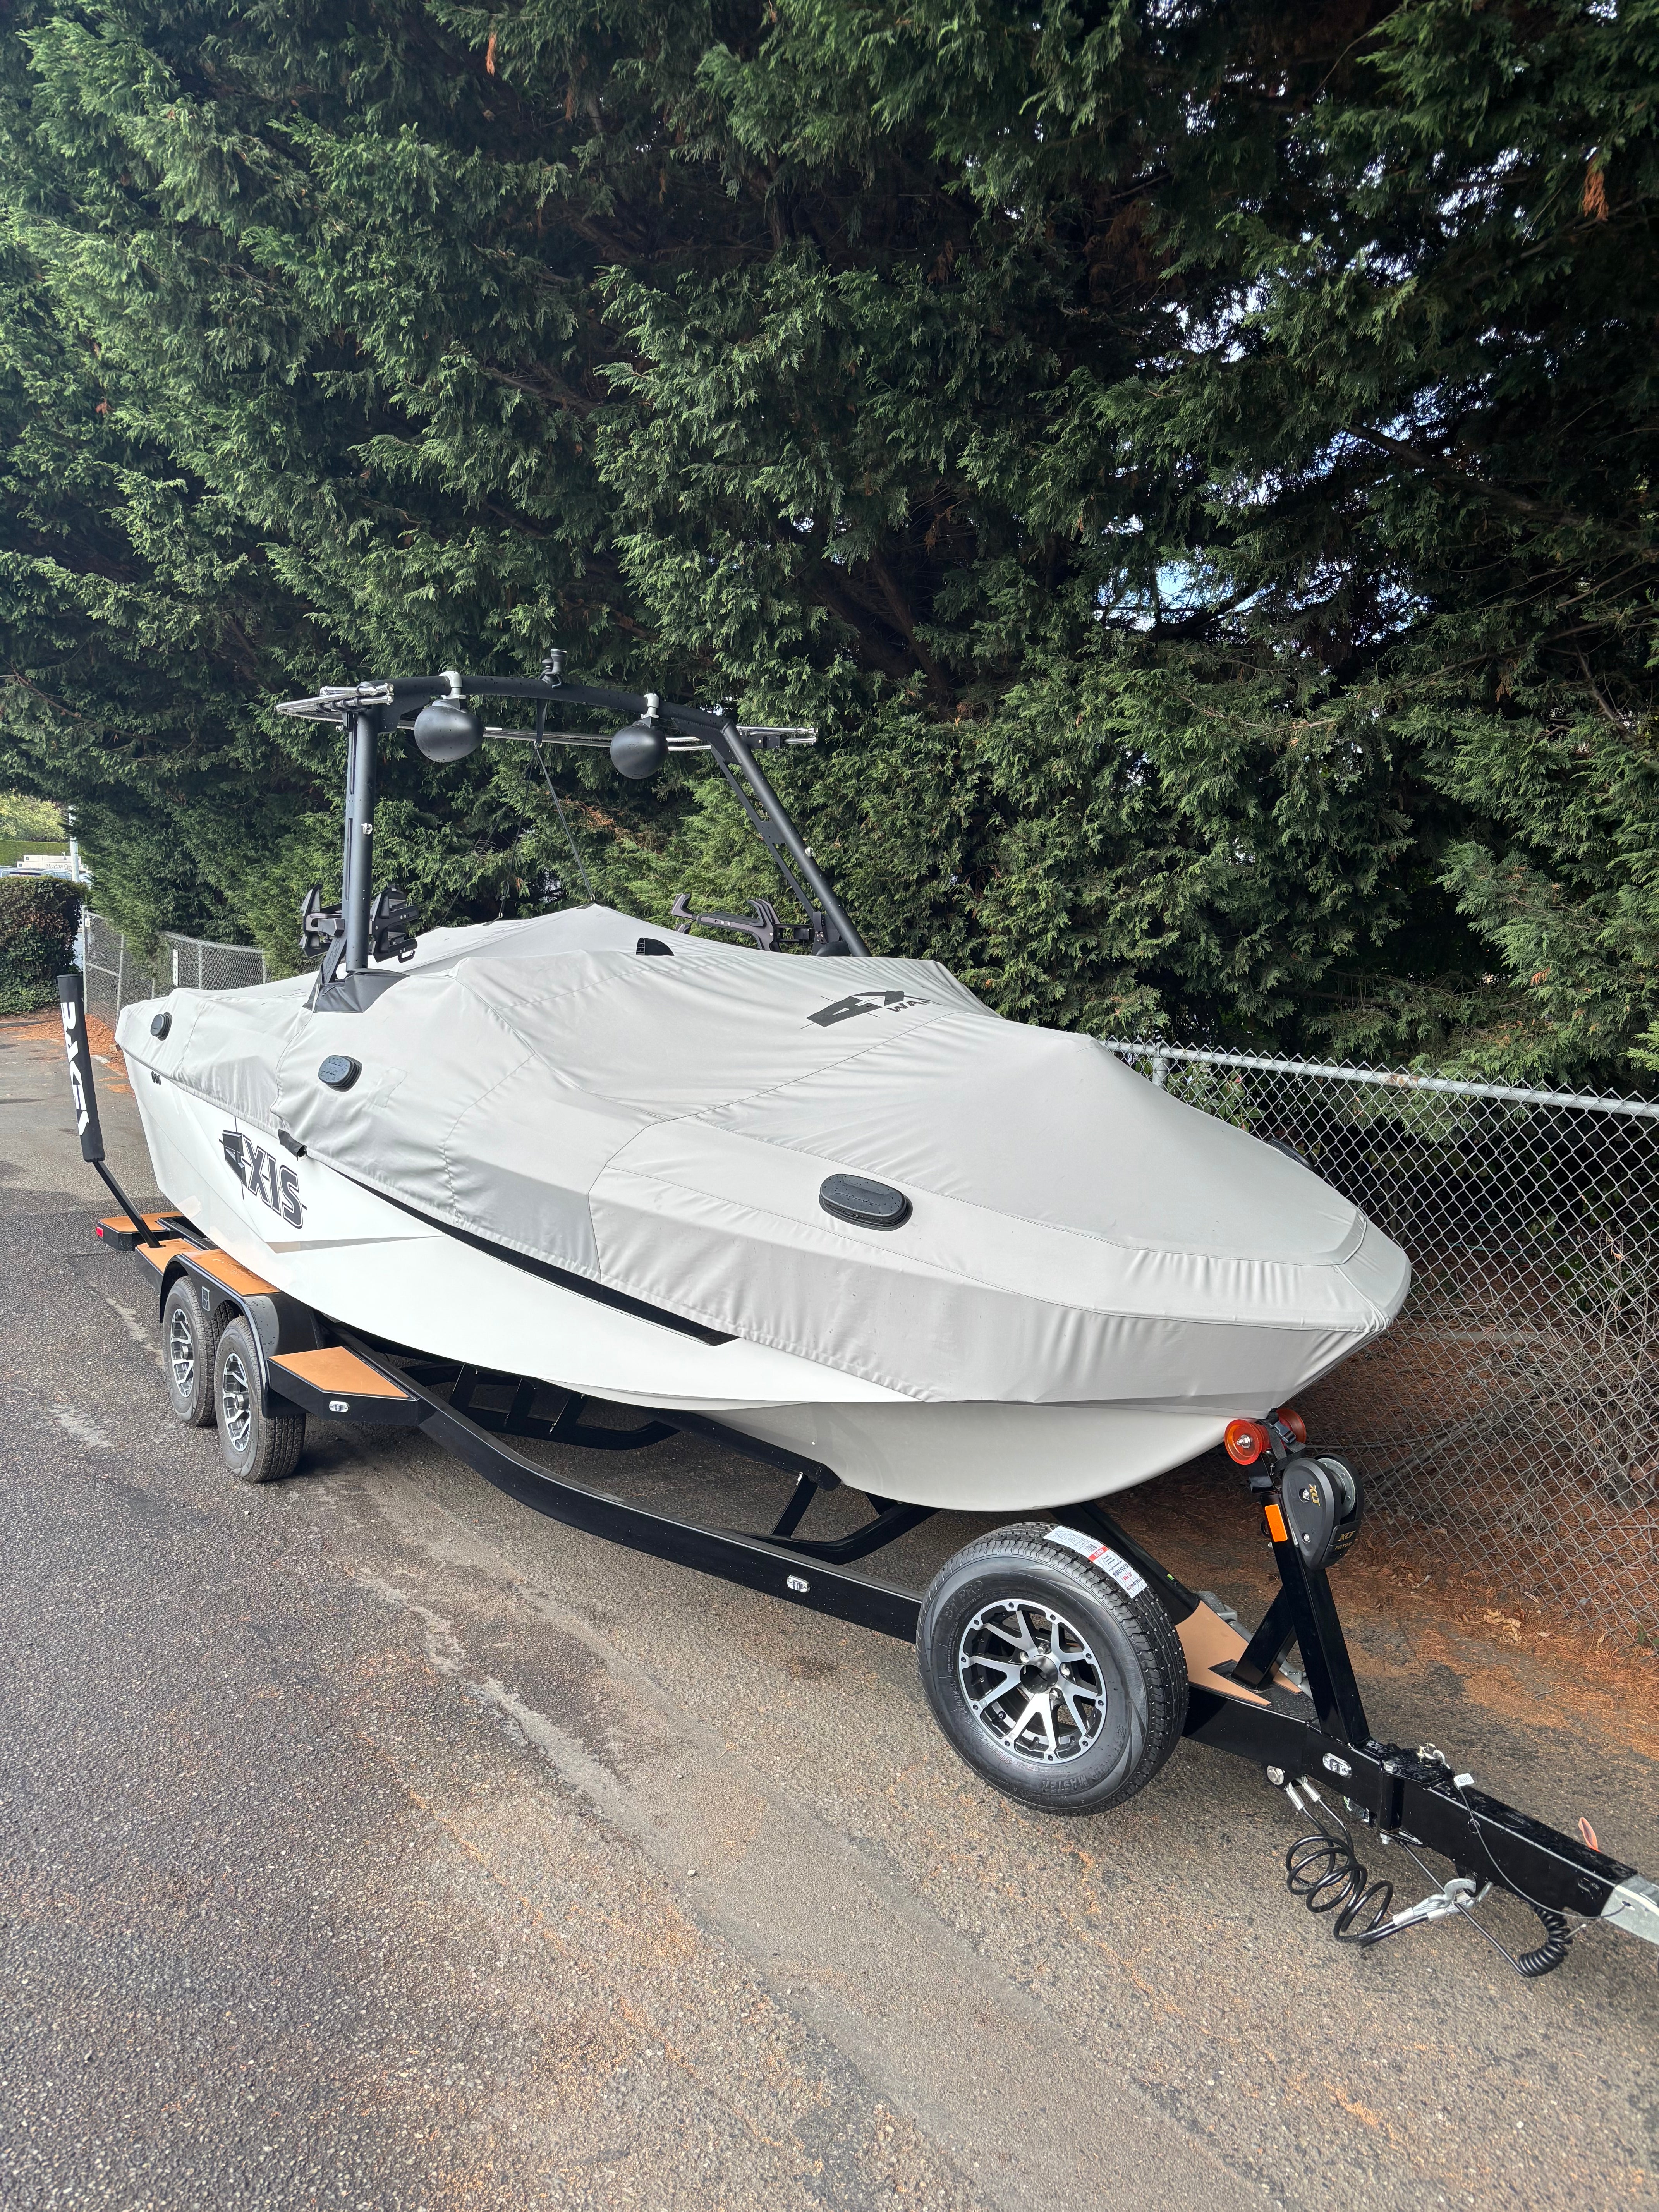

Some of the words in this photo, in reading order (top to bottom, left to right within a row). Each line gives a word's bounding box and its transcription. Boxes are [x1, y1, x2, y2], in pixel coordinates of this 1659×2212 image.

[222, 1130, 303, 1230] AXIS
[1309, 1483, 1321, 1507] XLT
[1337, 1530, 1356, 1541] XLT
[958, 1580, 983, 1603] PRO
